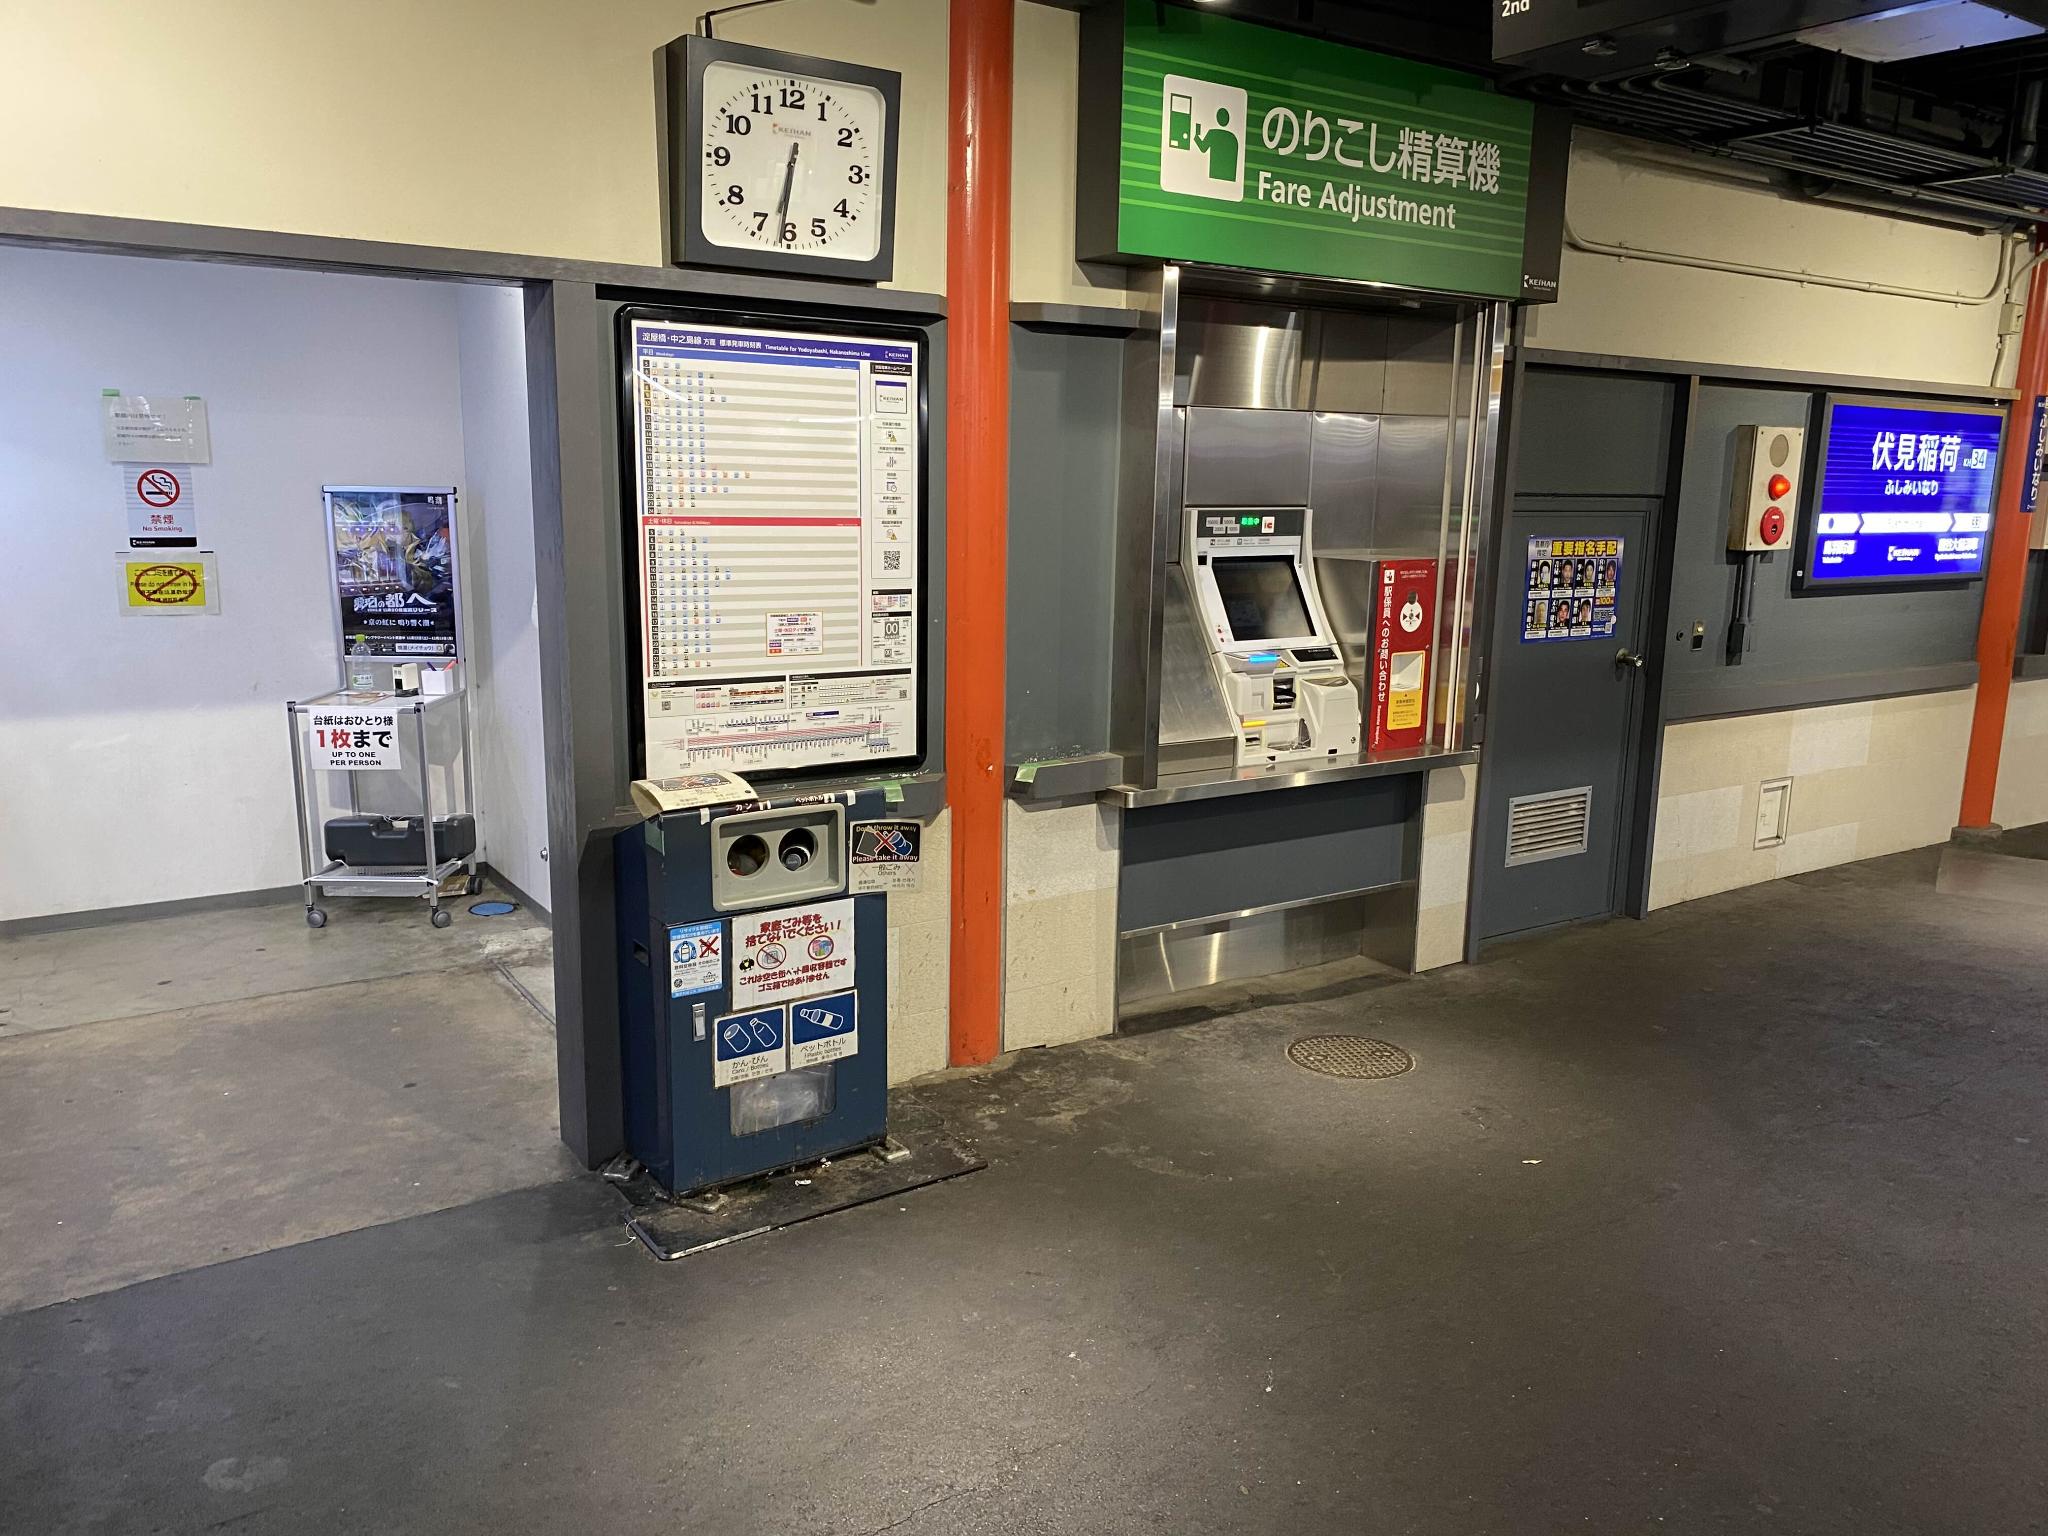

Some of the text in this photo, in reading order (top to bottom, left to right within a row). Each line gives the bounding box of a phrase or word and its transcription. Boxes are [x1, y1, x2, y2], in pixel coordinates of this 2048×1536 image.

[751, 93, 773, 115] 11
[780, 89, 805, 110] 12
[817, 102, 827, 121] 1
[726, 115, 751, 135] 10
[837, 128, 853, 147] 2
[713, 147, 730, 166] 9
[1262, 105, 1501, 195] のりこし精算機
[848, 165, 863, 184] 3
[727, 185, 744, 205] 8
[1258, 170, 1456, 229] Fare Adjustment
[833, 198, 849, 218] 4
[753, 212, 768, 232] 7
[811, 218, 826, 237] 5
[783, 223, 797, 241] 6
[1529, 278, 1557, 288] KEIHAN
[1872, 431, 1961, 472] 伏見稲荷
[1973, 450, 1986, 467] 34
[1885, 479, 1939, 496] ふしみいなり
[151, 514, 174, 525] 禁煙
[1551, 540, 1617, 557] 重要指名手配
[1378, 586, 1392, 702] 駅係員へのお問い合わせ
[313, 715, 394, 726] 台紙はおひとり様
[316, 728, 393, 749] 1枚まで
[735, 803, 752, 811] カン
[795, 794, 824, 802] ペットボトル
[852, 855, 874, 863] Please
[760, 914, 822, 933] 家庭ごみ等を
[745, 920, 841, 948] 捨てないでください！
[758, 972, 830, 992] ゴミ箱ではありません
[800, 1037, 847, 1053] ペットボトル
